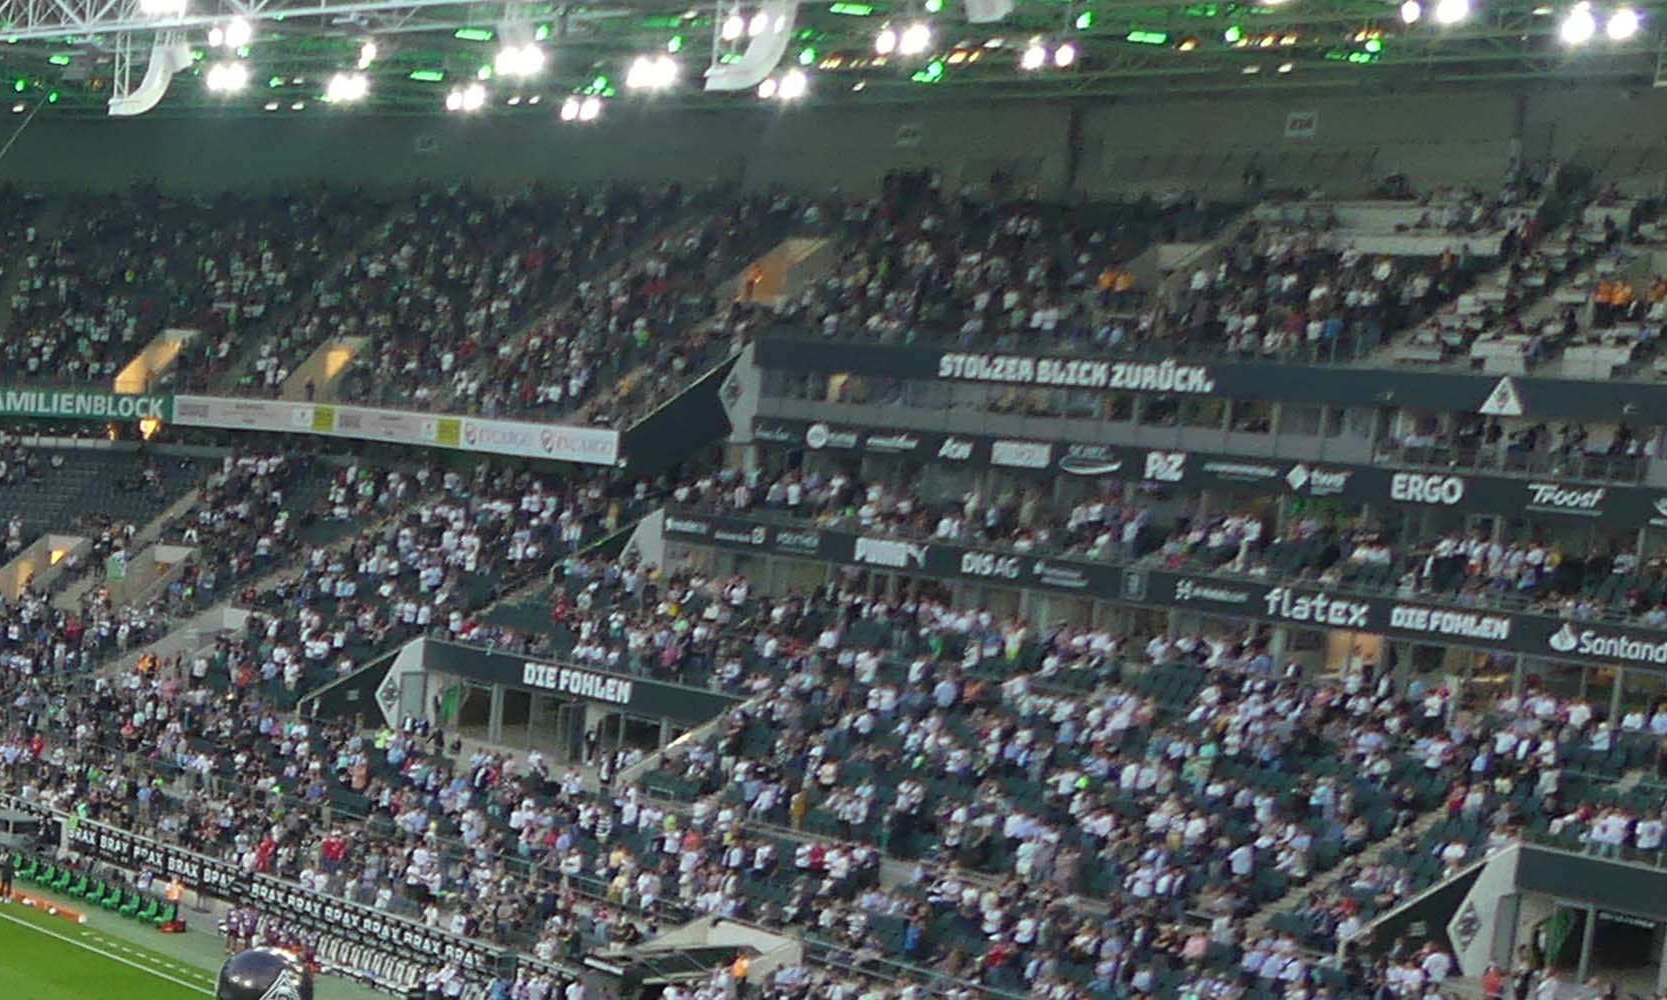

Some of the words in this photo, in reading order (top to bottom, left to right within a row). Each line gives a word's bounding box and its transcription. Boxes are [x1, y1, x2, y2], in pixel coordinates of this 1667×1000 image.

[939, 353, 1035, 382] STOLZER
[1036, 358, 1108, 387] BLICK
[1109, 357, 1215, 392] ZURÜCK.
[1391, 473, 1464, 505] ERGO
[1527, 483, 1607, 509] Troost
[1264, 587, 1370, 627] flatex
[1391, 604, 1427, 630] DIE
[1428, 608, 1511, 640] FOHLEN
[523, 662, 558, 690] DIE
[558, 668, 632, 704] FOHLEN
[167, 855, 200, 879] BRAX
